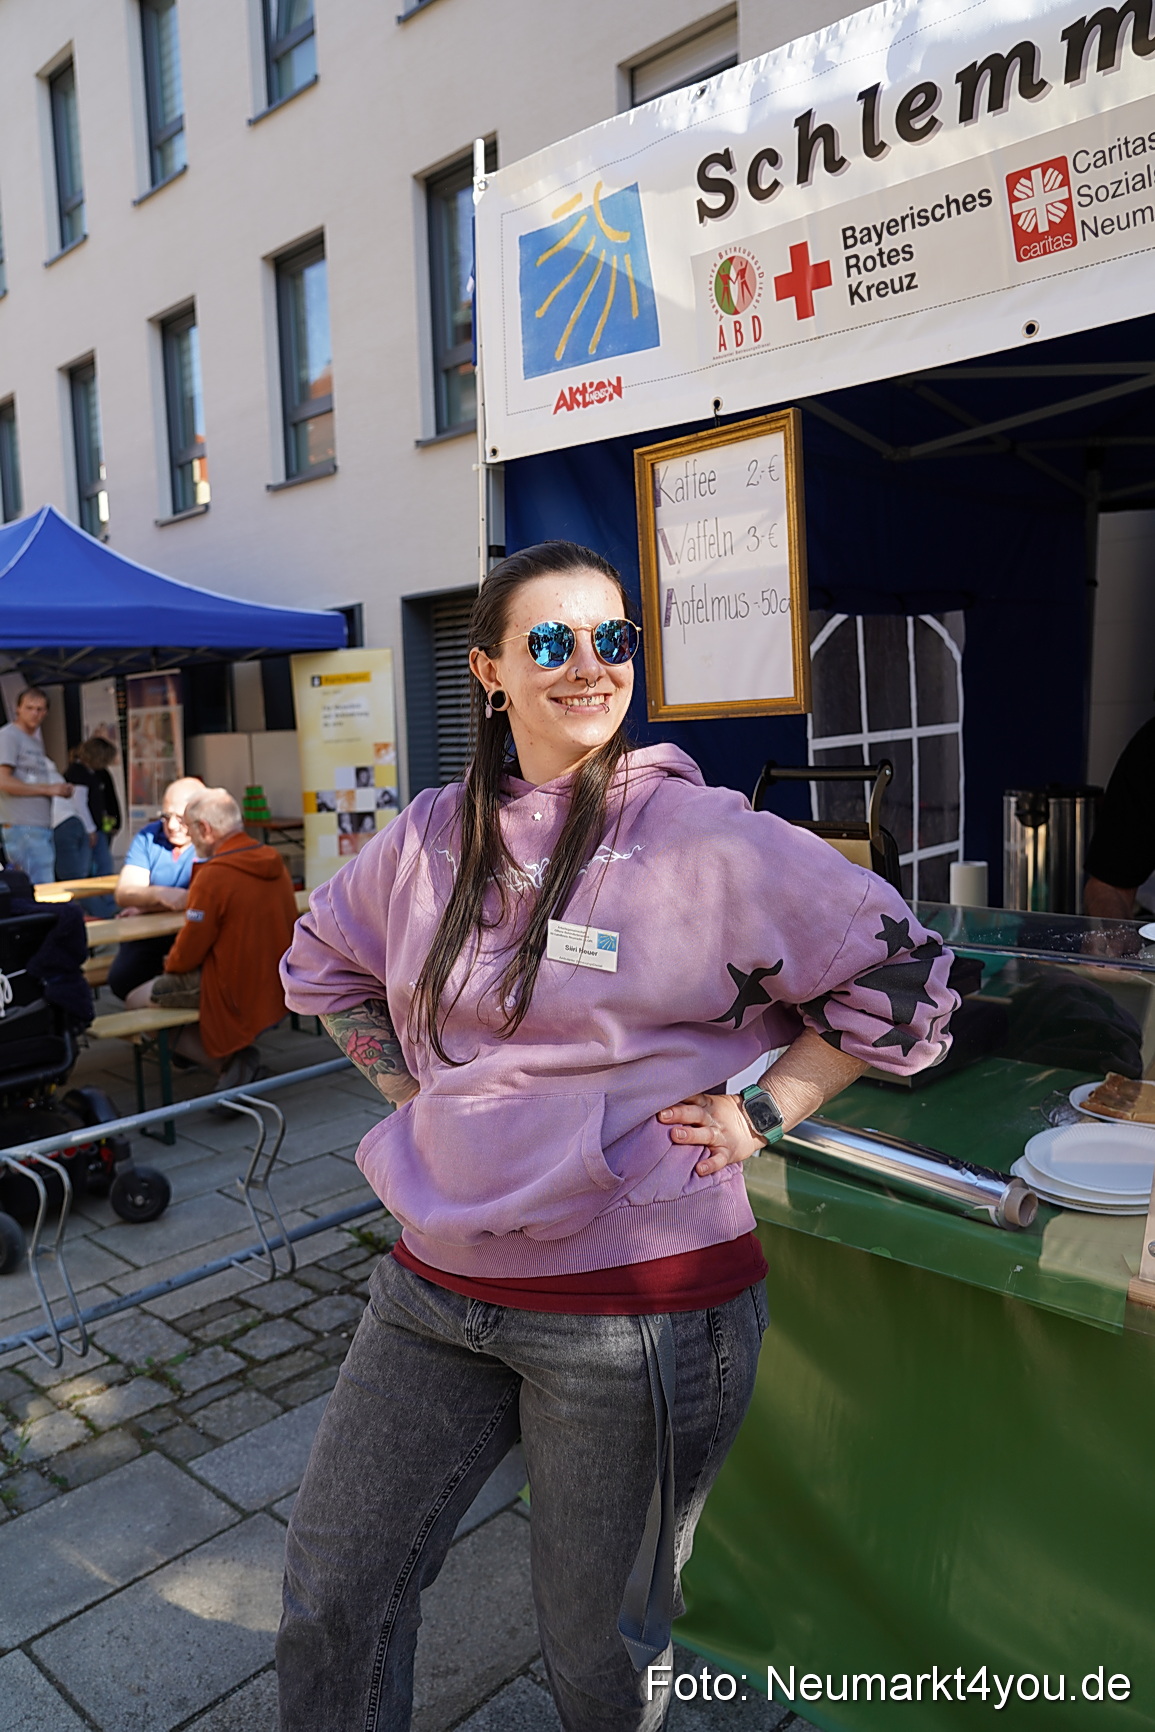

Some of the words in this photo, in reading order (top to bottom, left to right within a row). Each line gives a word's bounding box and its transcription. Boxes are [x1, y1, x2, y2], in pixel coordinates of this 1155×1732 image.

[1076, 164, 1155, 208] Sozial
[841, 188, 993, 251] Bayerisches
[845, 243, 914, 279] Rotes
[1020, 233, 1073, 260] caritas
[848, 272, 919, 306] Kreuz
[718, 315, 762, 353] ABD
[655, 459, 716, 508] Kaffee
[657, 517, 734, 566] Waffeln
[664, 583, 750, 645] Apfelmus
